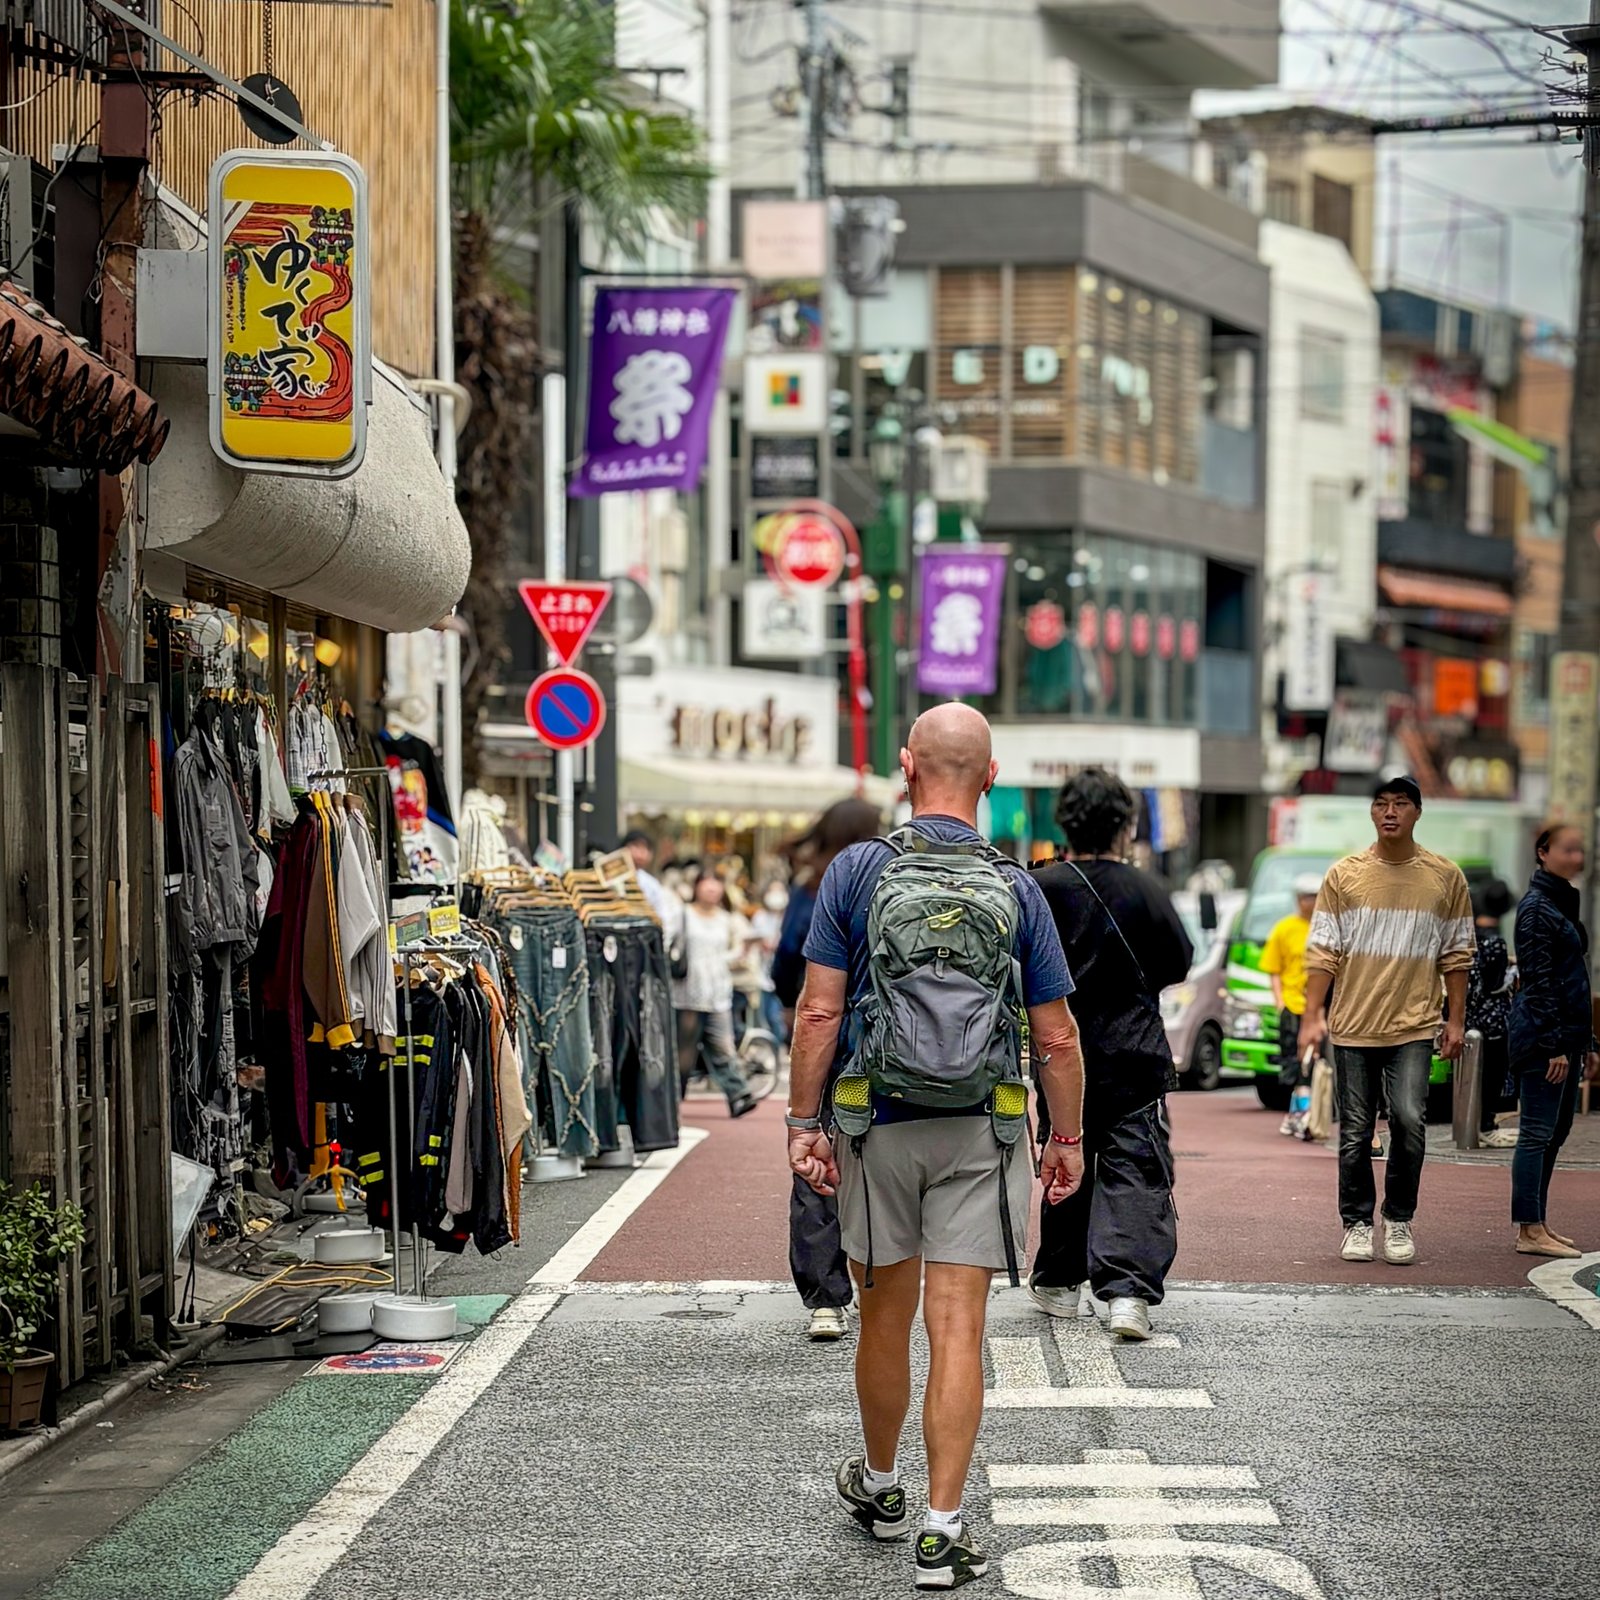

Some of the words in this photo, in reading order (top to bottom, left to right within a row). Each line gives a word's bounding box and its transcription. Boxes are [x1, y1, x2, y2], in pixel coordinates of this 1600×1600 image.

[608, 350, 694, 448] 祭
[540, 591, 594, 613] 止まれ
[548, 615, 586, 633] STOP
